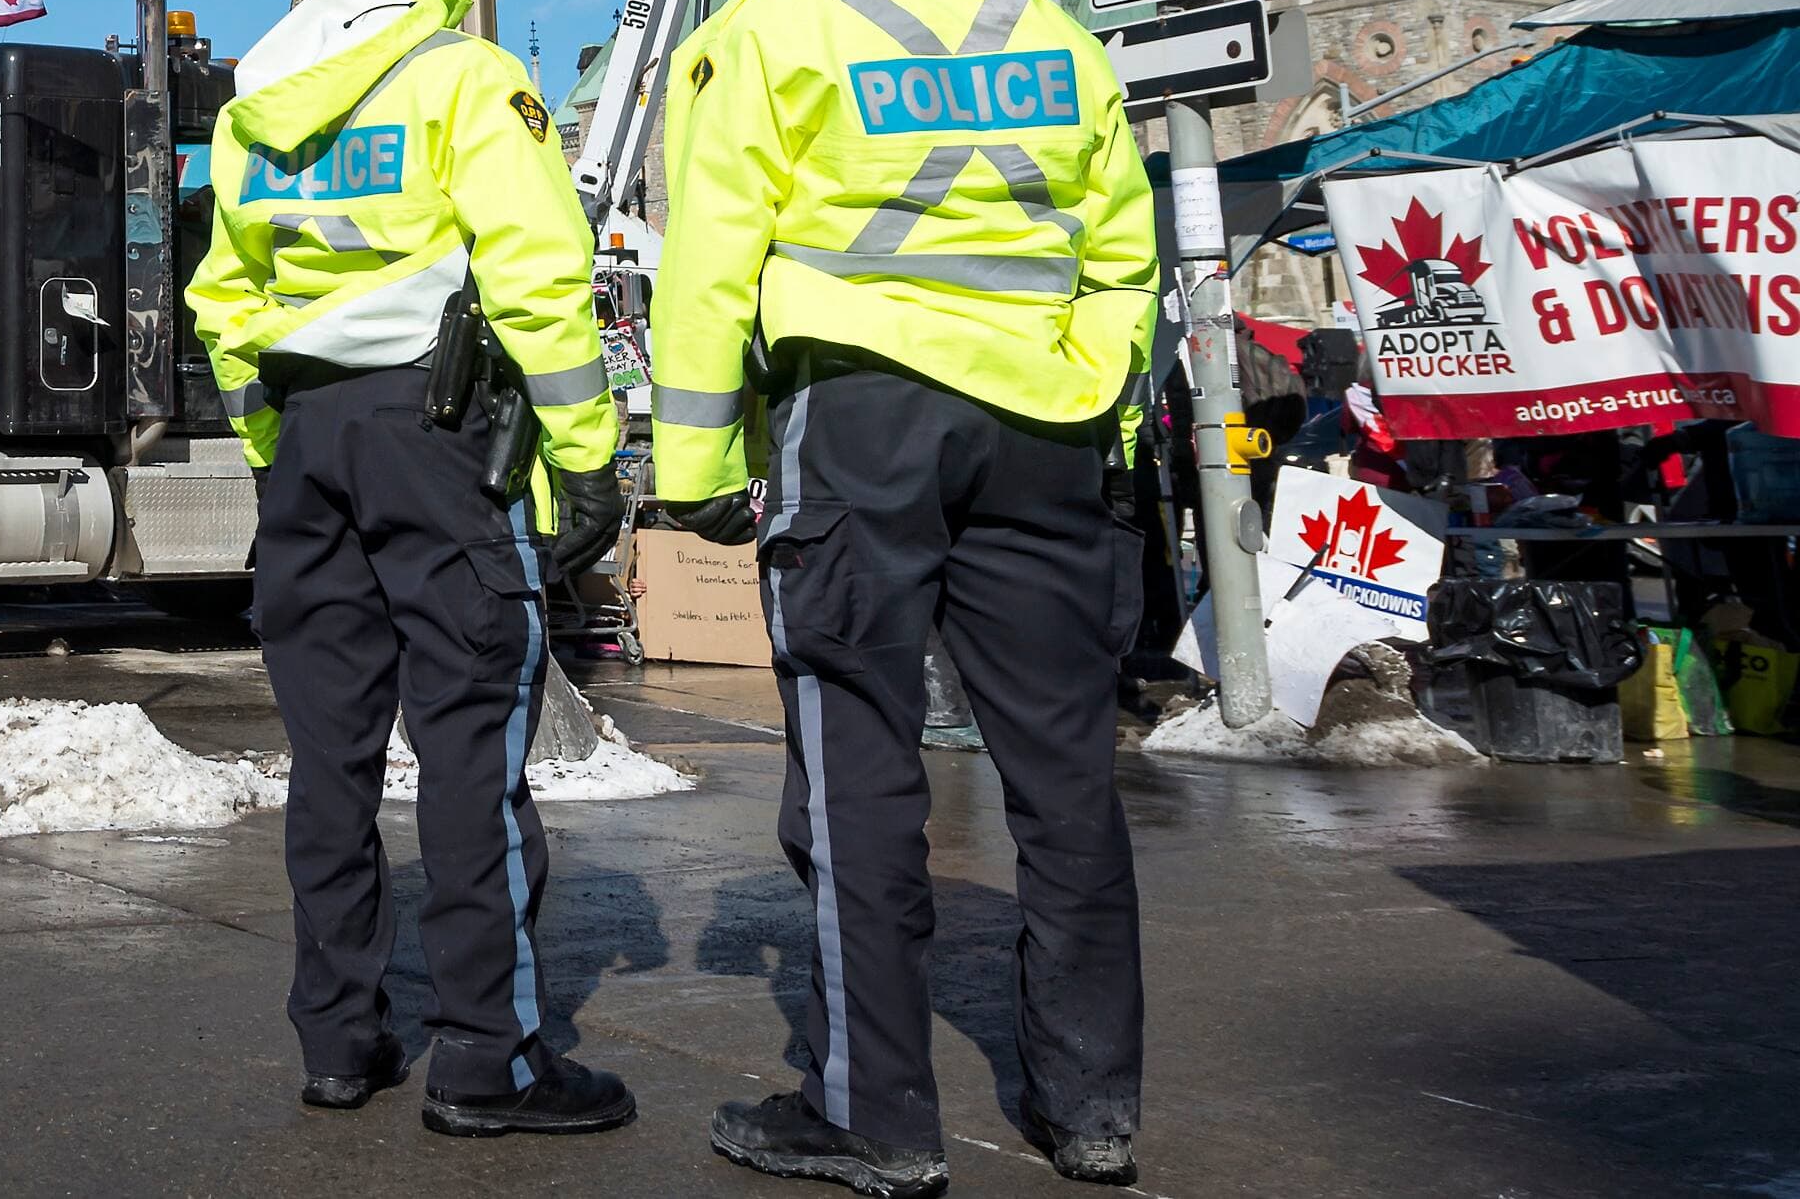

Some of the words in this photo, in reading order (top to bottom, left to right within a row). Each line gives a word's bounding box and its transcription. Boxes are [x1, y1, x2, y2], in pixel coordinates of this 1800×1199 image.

[859, 58, 1074, 127] POLICE
[241, 131, 399, 196] POLICE
[1532, 288, 1576, 345] &
[1378, 330, 1474, 355] ADOPT
[1484, 329, 1506, 352] A
[1377, 353, 1517, 378] TRUCKER
[1514, 386, 1737, 423] adopt-a-trucer.ca
[676, 551, 729, 569] Donations
[738, 559, 754, 569] for
